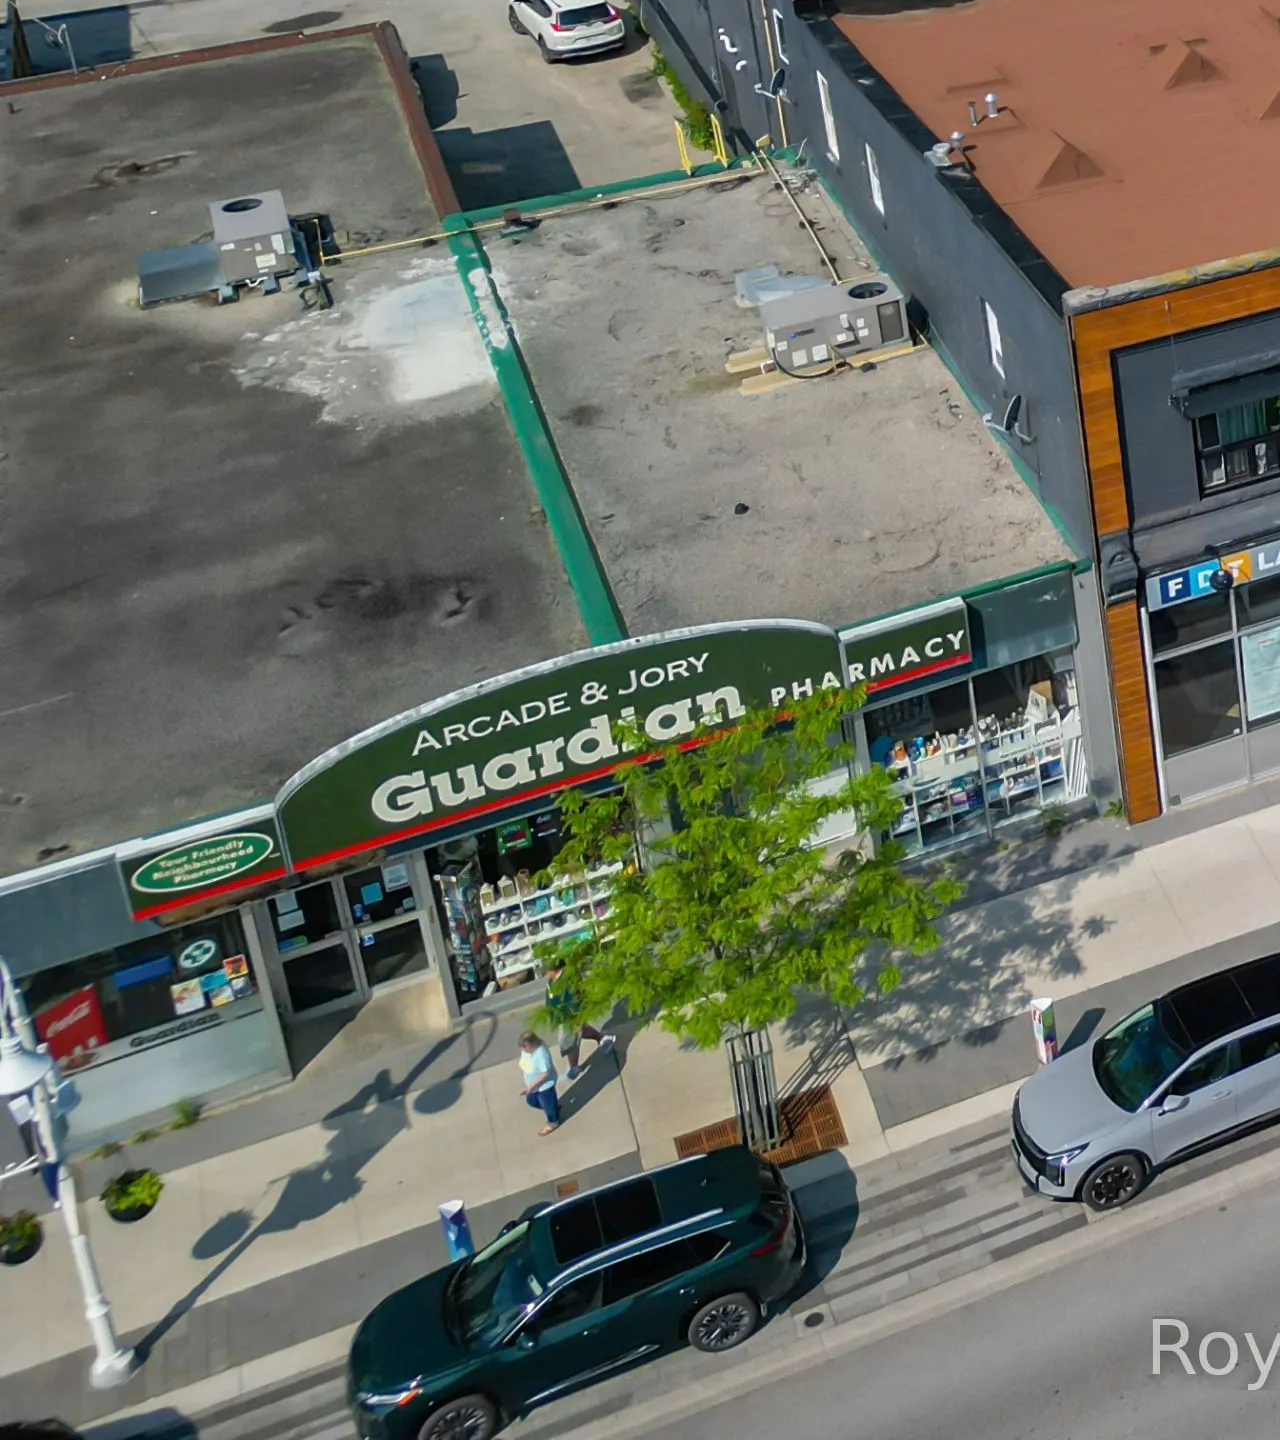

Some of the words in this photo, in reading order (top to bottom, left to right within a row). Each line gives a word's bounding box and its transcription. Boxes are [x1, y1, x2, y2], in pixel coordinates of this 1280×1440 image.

[411, 692, 572, 757] ARCADE
[580, 681, 609, 706] &
[618, 652, 710, 696] JORY
[371, 684, 746, 824] Guardian
[771, 629, 965, 708] PHARMACY
[191, 839, 244, 860] Friendly
[174, 861, 237, 884] Pharmacy
[129, 1012, 222, 1048] Guardian
